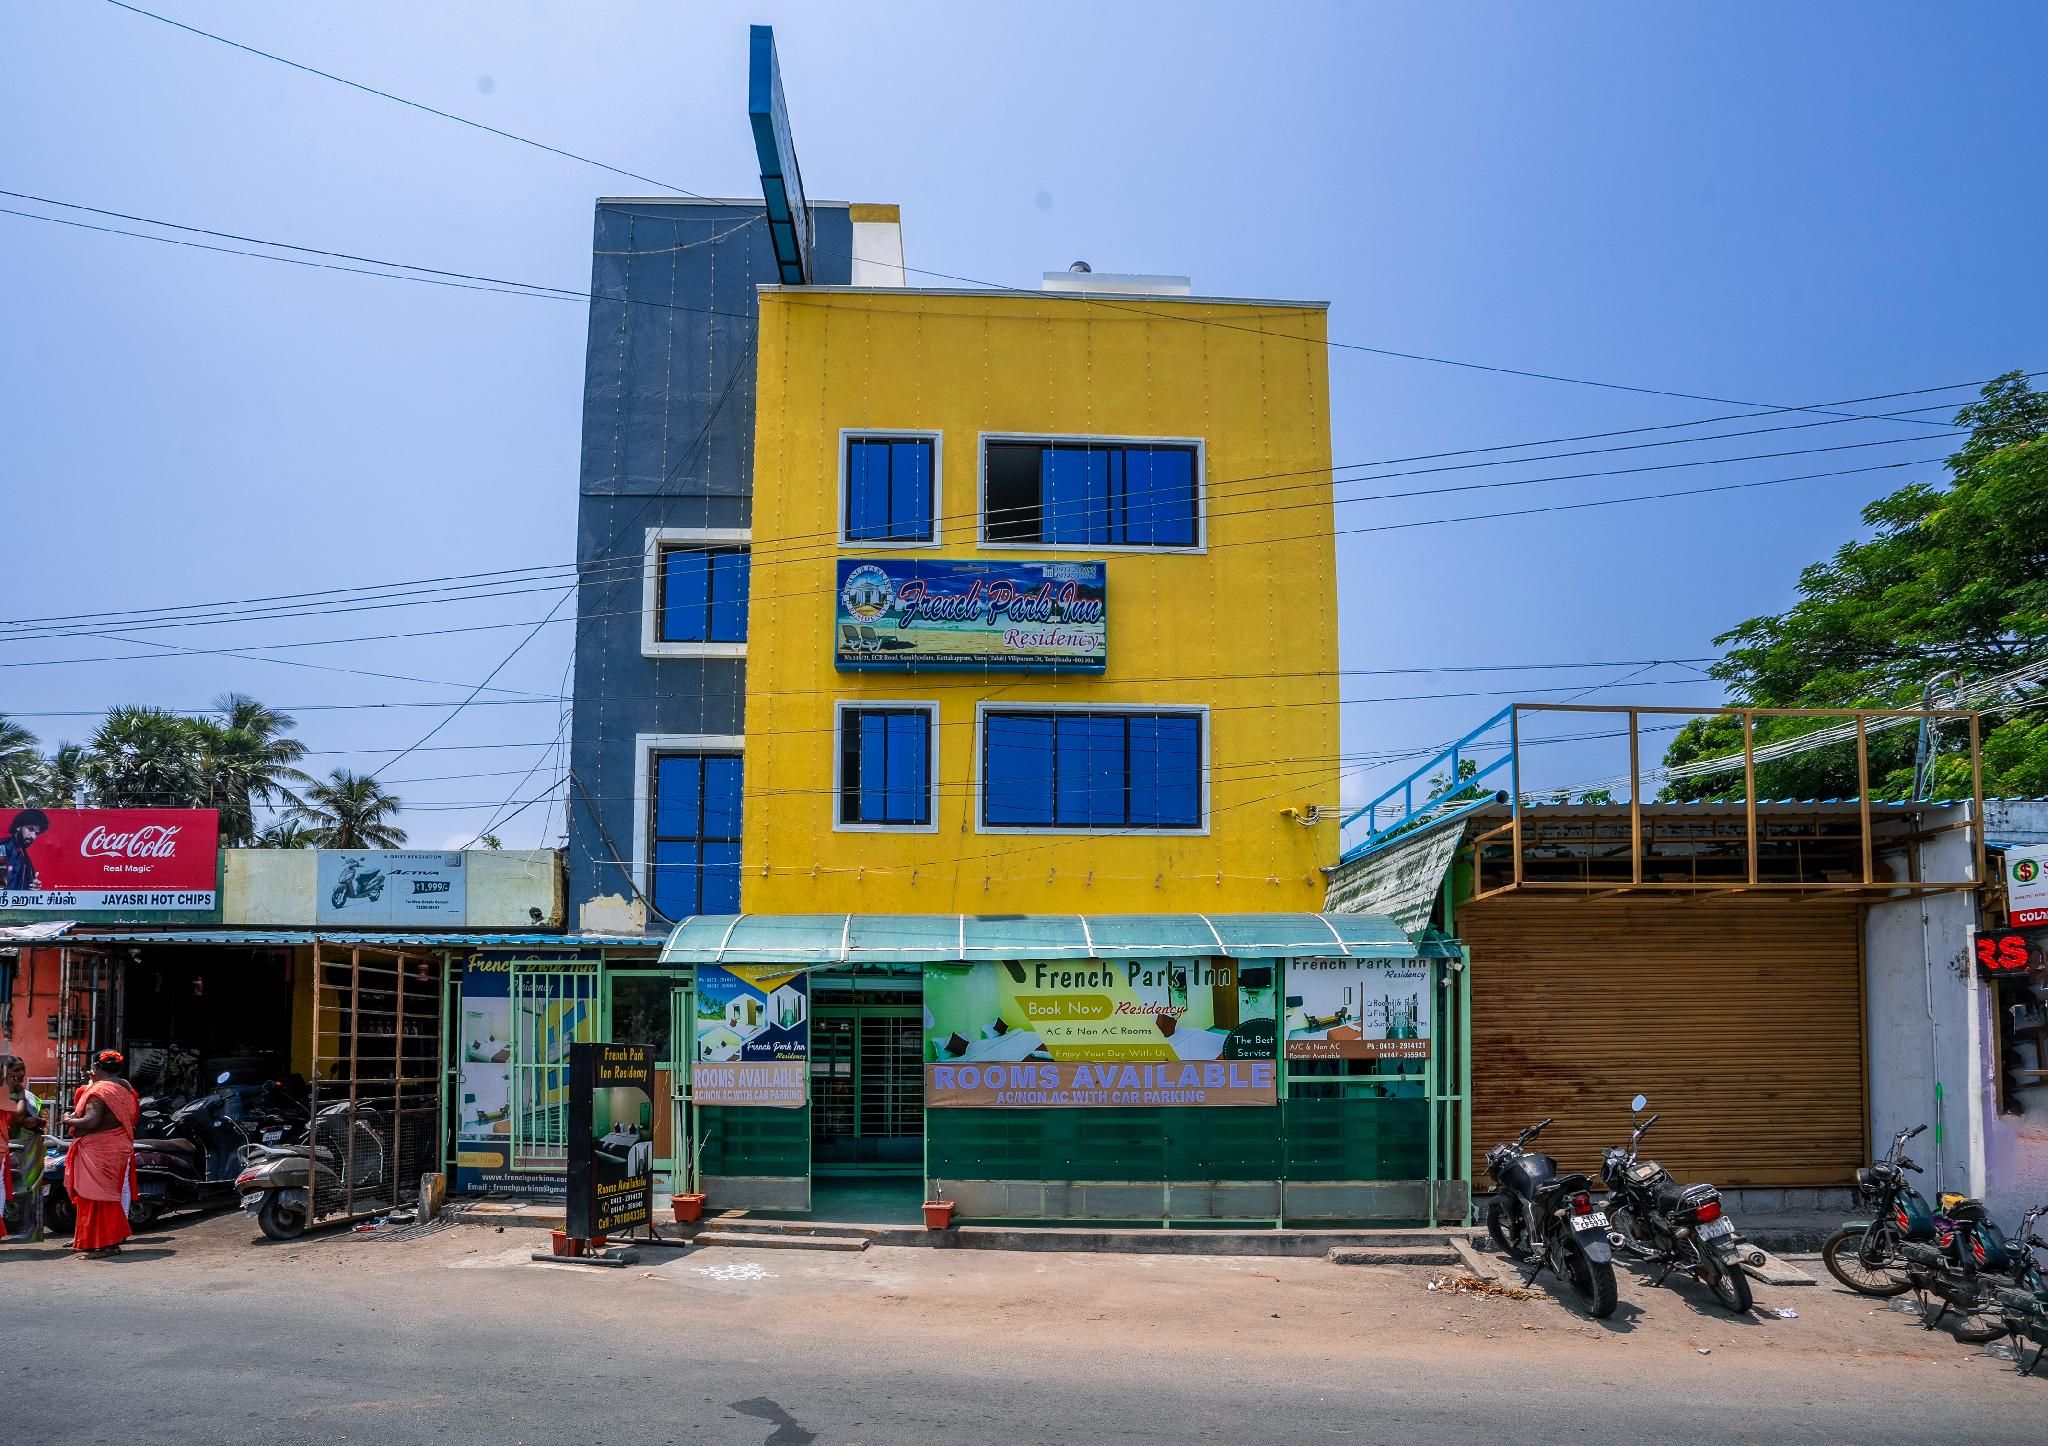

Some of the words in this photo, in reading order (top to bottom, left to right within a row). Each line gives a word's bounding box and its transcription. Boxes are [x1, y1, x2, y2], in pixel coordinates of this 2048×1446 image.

[900, 579, 982, 628] French
[987, 580, 1052, 626] Park
[1058, 579, 1101, 623] Inn
[1004, 627, 1100, 652] Residency
[81, 825, 183, 858] Coca-Cola
[103, 864, 123, 873] Real
[101, 893, 148, 906] JAYASRI
[150, 893, 175, 906] HOT
[179, 893, 211, 906] CHIPS
[1293, 957, 1347, 971] French
[1356, 957, 1392, 970] Park
[1401, 957, 1427, 969] Inn
[1035, 961, 1114, 989] French
[1128, 960, 1180, 988] Park
[1193, 959, 1231, 987] Inn
[1384, 969, 1426, 982] Residency
[1029, 1001, 1062, 1016] Book
[1069, 1001, 1103, 1015] Now
[1115, 1000, 1186, 1020] Residency
[1046, 1027, 1062, 1036] AC
[1065, 1027, 1073, 1036] &
[1077, 1027, 1098, 1036] Non
[1101, 1027, 1119, 1035] AC
[1121, 1027, 1152, 1036] Rooms
[747, 1041, 772, 1052] French
[793, 1040, 806, 1051] Inn
[1233, 1035, 1252, 1045] The
[1255, 1035, 1274, 1045] Best
[1289, 1043, 1304, 1051] A/C
[1329, 1042, 1340, 1050] AC
[1379, 1042, 1395, 1050] 0413
[605, 1047, 628, 1061] French
[630, 1047, 644, 1061] Park
[1055, 1050, 1081, 1060] Enjoy
[1083, 1050, 1105, 1058] Your
[1108, 1050, 1126, 1058] Day
[1128, 1049, 1151, 1057] With
[1237, 1049, 1271, 1058] Service
[600, 1065, 612, 1079] Inn
[614, 1065, 648, 1082] Residency
[694, 1068, 735, 1089] ROOMS
[739, 1067, 803, 1089] AVAILABLE
[934, 1065, 1060, 1090] ROOMS
[1071, 1063, 1272, 1090] AVAILABLE
[722, 1090, 734, 1101] AC
[733, 1090, 752, 1101] WITH
[754, 1090, 769, 1101] CAR
[771, 1090, 803, 1102] PARKING
[996, 1091, 1047, 1104] AC/NON
[1049, 1090, 1070, 1104] AC
[1072, 1090, 1108, 1104] WITH
[1112, 1090, 1140, 1104] CAR
[1144, 1090, 1206, 1104] PARKING
[467, 1182, 488, 1191] Email
